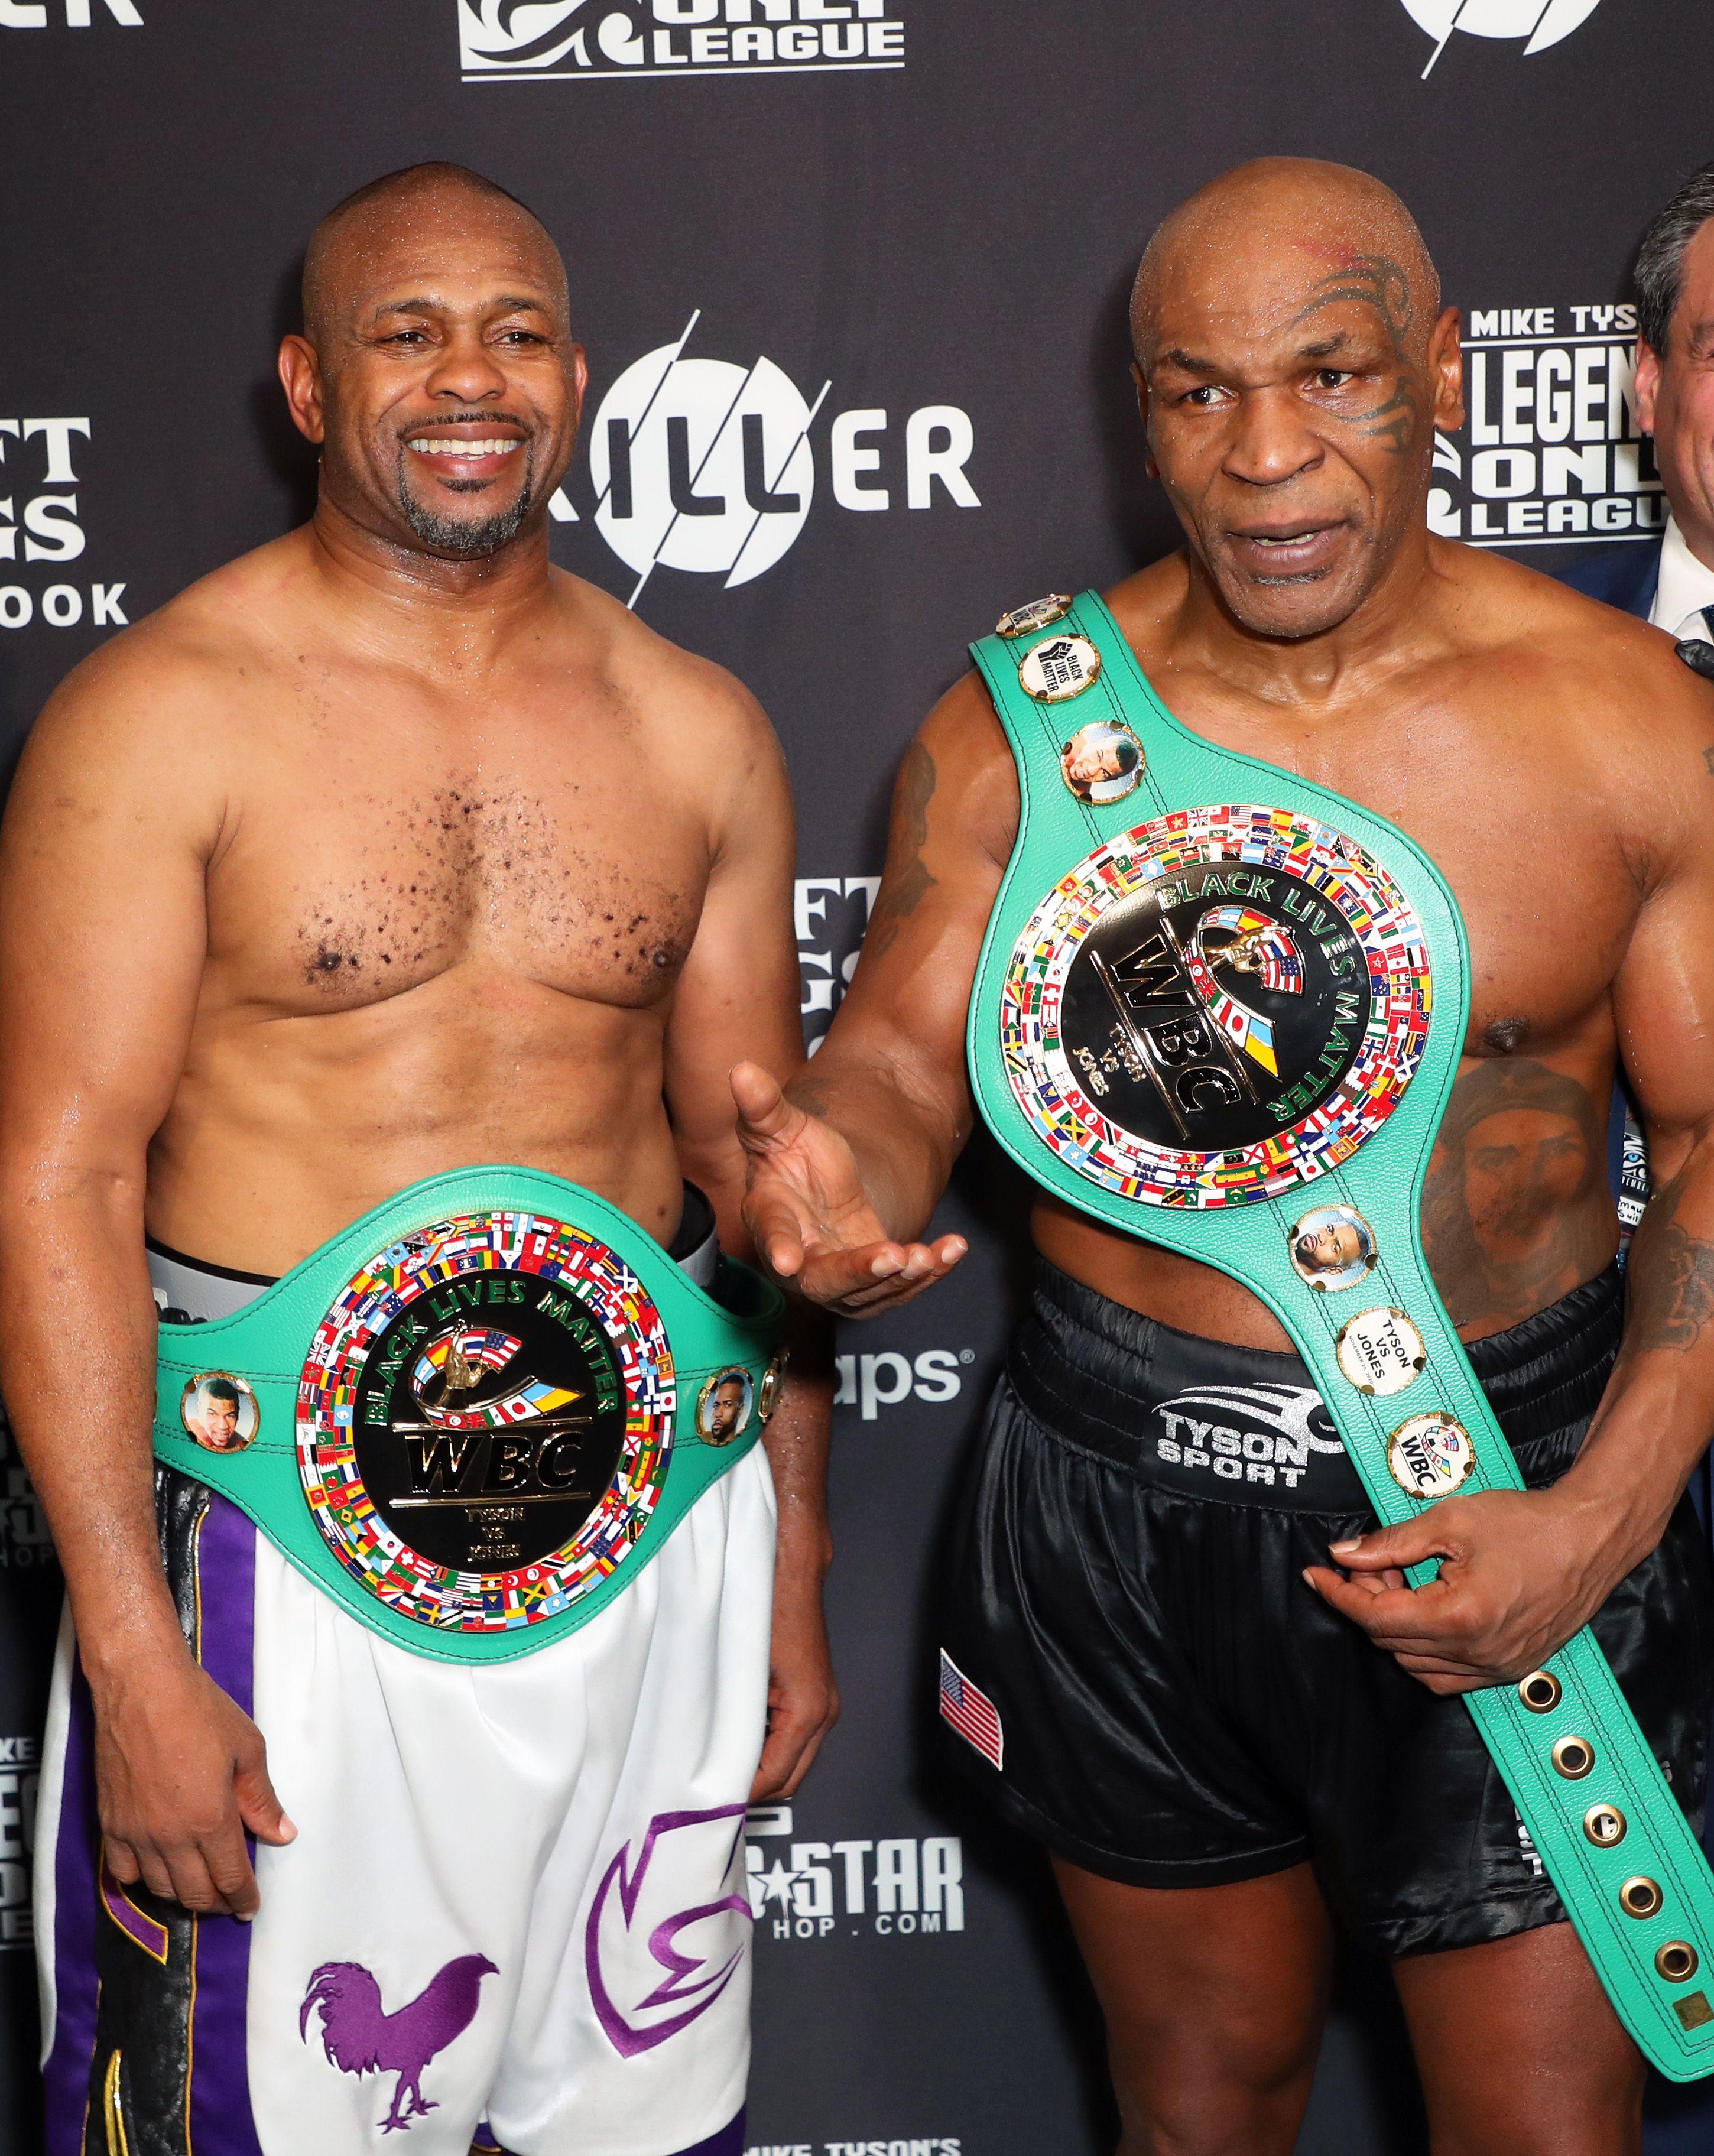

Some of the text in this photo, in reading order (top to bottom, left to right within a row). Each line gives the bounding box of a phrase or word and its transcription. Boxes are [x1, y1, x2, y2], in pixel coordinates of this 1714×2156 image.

[653, 21, 905, 64] LEAGUE
[1471, 307, 1554, 337] MIKE
[547, 405, 982, 521] ILLER
[1041, 661, 1059, 693] MATTER
[1055, 661, 1070, 683] LIVES
[1067, 654, 1083, 681] BLACK
[1155, 872, 1360, 1121] BLACK LIVES MATTER
[1110, 934, 1241, 1113] WBC
[1072, 1047, 1109, 1097] JONES
[1099, 1048, 1119, 1073] VS
[365, 1280, 618, 1425] BLACK LIVES MATTER
[1357, 1333, 1385, 1379] JONES
[1376, 1337, 1390, 1358] VS
[1383, 1319, 1411, 1368] TYSON
[1159, 1408, 1308, 1466] TYSON
[1401, 1436, 1437, 1487] WBC
[404, 1431, 585, 1494] WBC
[1157, 1438, 1306, 1488] SPORT
